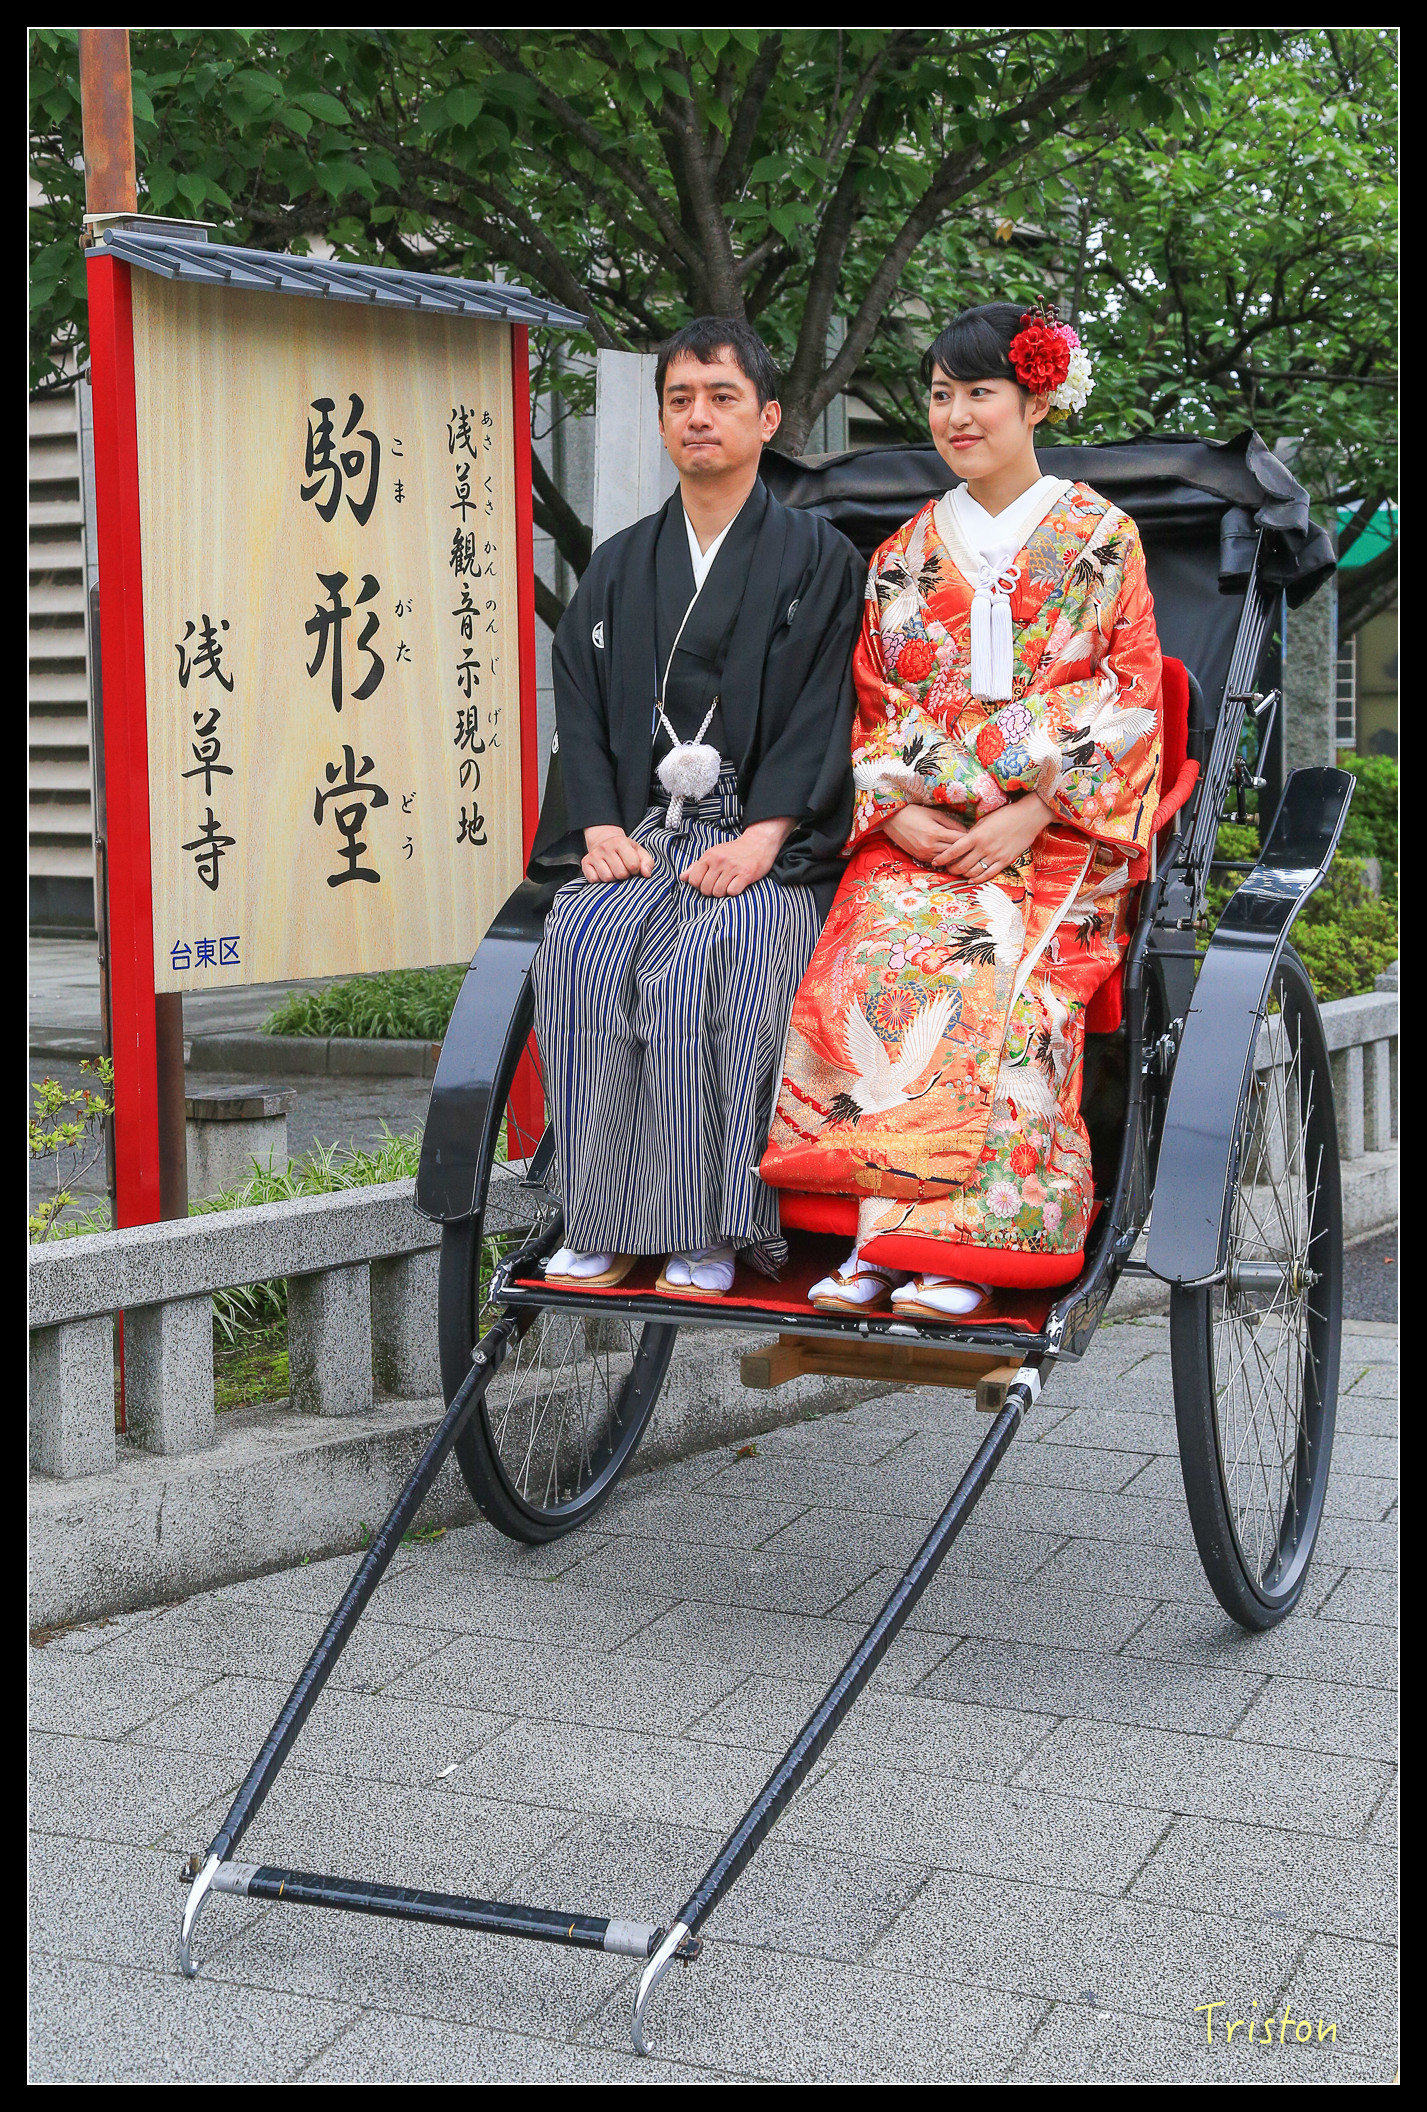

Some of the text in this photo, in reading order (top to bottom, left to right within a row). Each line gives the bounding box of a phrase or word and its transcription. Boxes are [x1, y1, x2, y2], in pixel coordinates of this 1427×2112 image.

[175, 614, 236, 891] 浅草寺
[301, 393, 389, 887] 駒形堂
[447, 404, 487, 846] 浅草観音示現の地
[170, 936, 241, 970] 台東区
